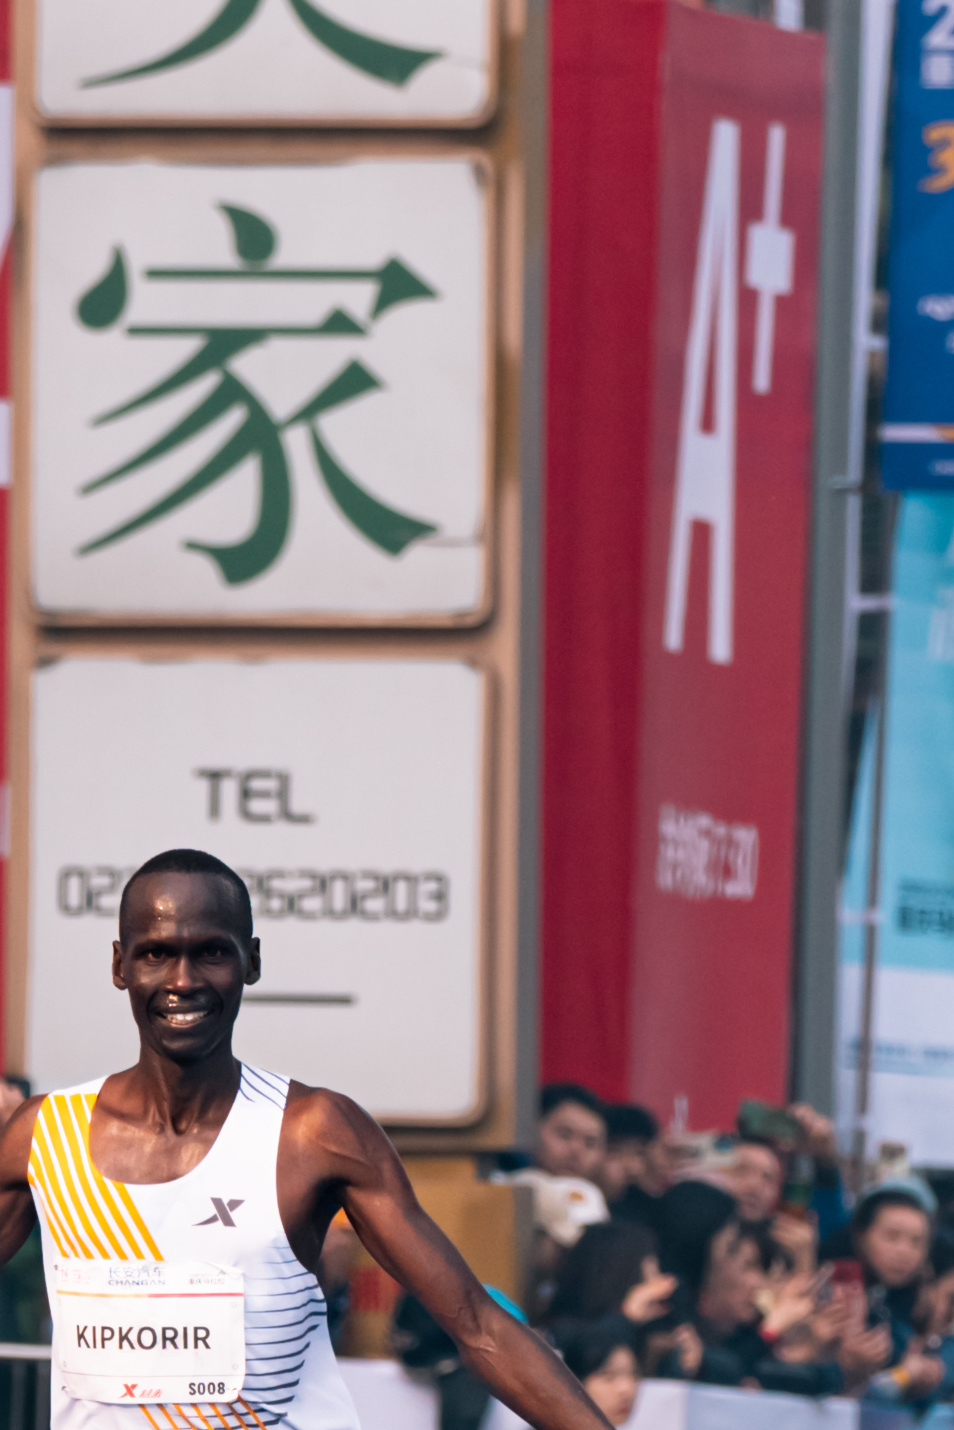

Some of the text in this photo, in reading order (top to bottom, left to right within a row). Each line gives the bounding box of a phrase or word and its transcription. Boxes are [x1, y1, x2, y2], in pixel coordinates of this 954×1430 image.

[75, 0, 443, 590] 家
[194, 767, 316, 825] TEL
[107, 1278, 166, 1286] CHANGAN
[76, 1324, 212, 1350] KIPKORIR
[188, 1382, 226, 1396] S008
